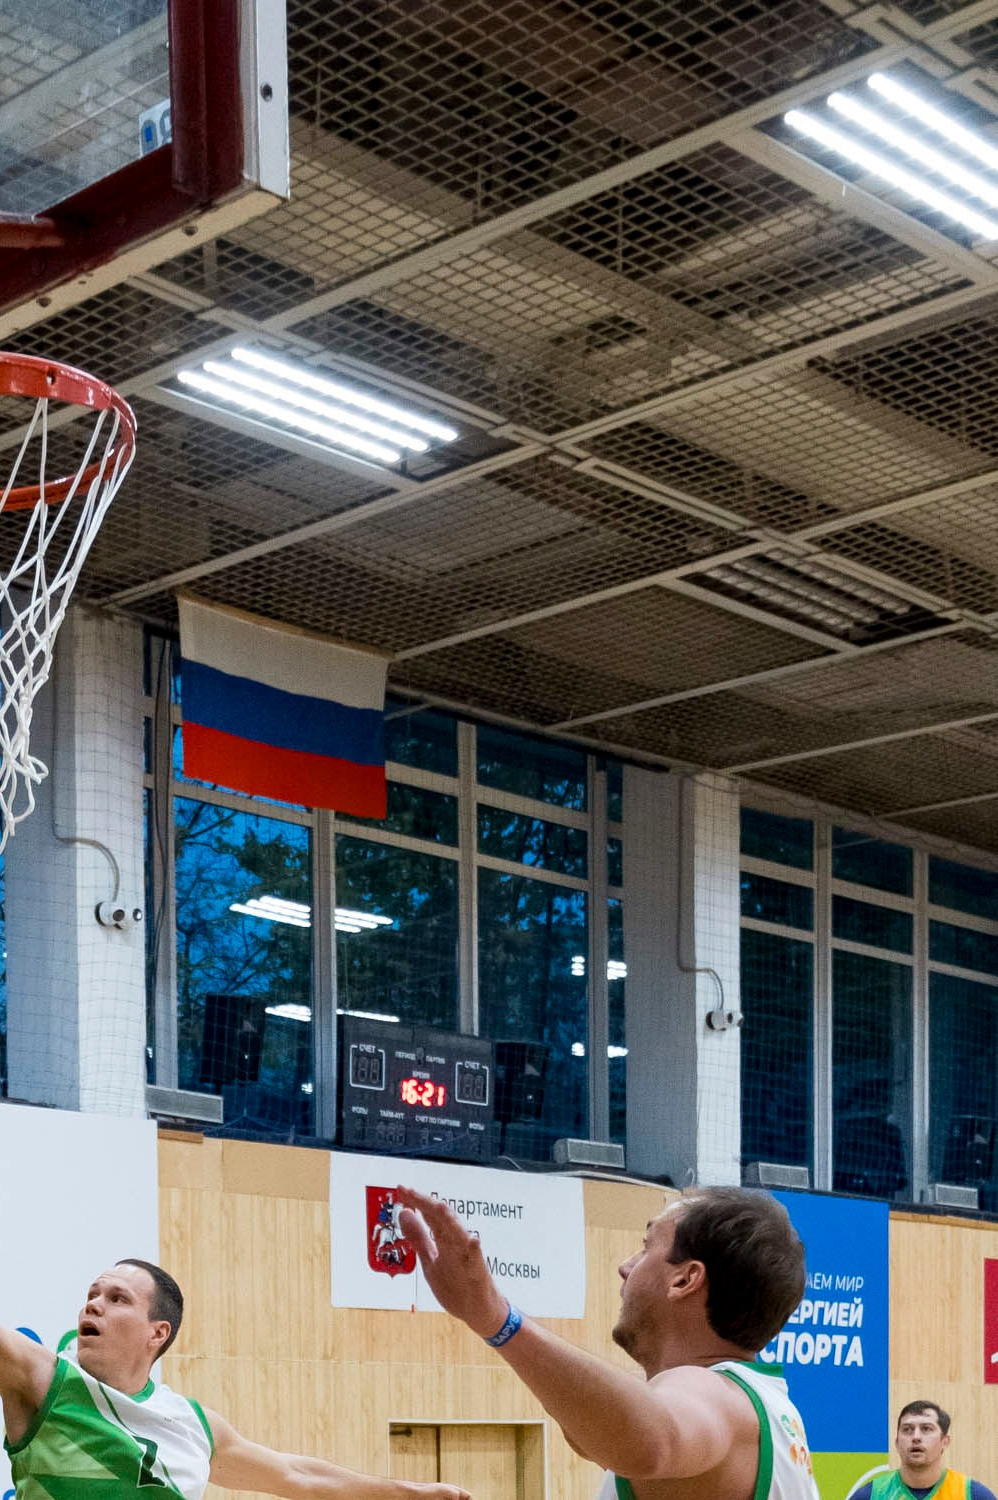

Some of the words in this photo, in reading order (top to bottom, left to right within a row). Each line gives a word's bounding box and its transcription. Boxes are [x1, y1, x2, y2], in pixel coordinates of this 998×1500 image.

[401, 1078, 446, 1107] 16:21
[487, 1255, 541, 1279] Москвы
[835, 1275, 864, 1292] МИР
[759, 1332, 864, 1367] СПОРТА
